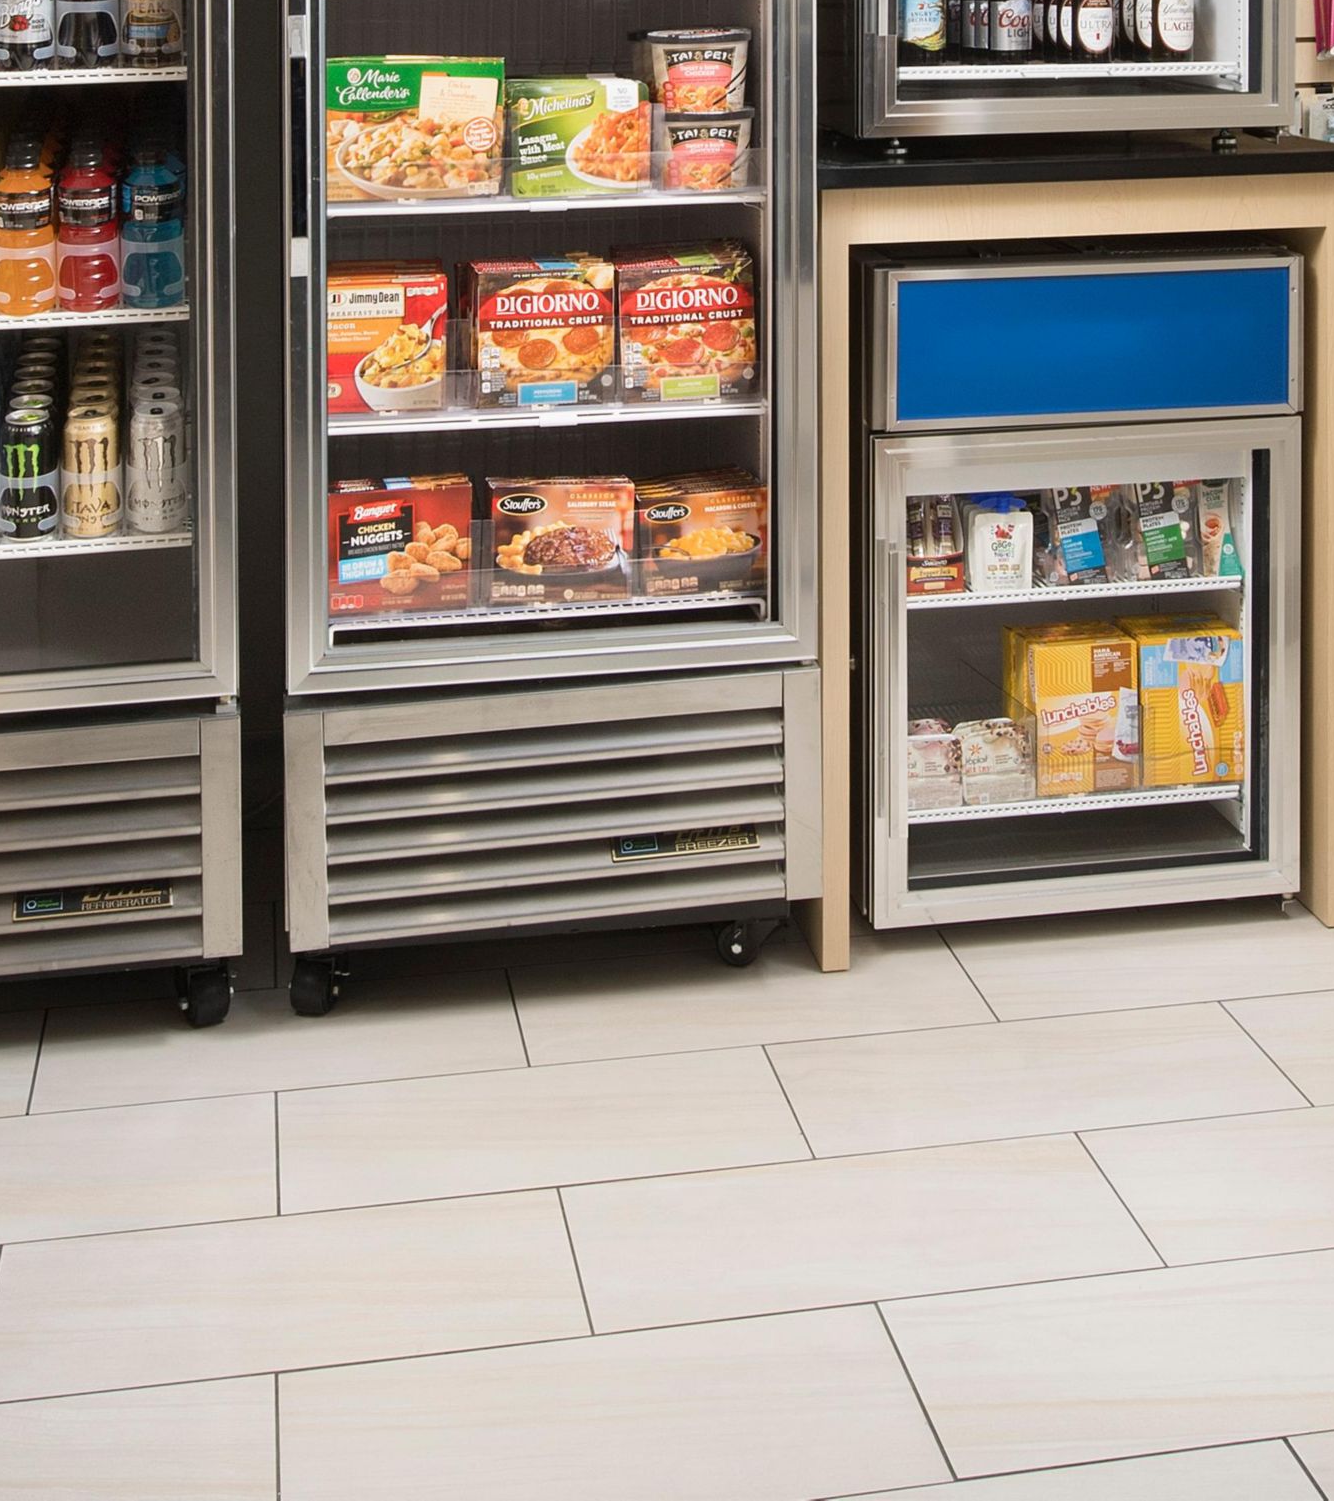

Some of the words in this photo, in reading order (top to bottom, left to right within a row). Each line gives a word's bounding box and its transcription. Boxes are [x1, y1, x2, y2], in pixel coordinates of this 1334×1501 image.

[672, 51, 693, 63] TAI
[703, 50, 727, 61] PEI
[359, 68, 400, 88] Marie
[336, 86, 409, 105] Callender's
[524, 94, 592, 120] Michelina's
[518, 133, 558, 146] Lasagna
[677, 128, 699, 139] TAI
[709, 128, 732, 138] PEI
[519, 146, 542, 156] with
[542, 141, 566, 152] Meat
[520, 155, 547, 165] Sauce
[349, 291, 378, 304] Jimmy
[378, 291, 400, 304] Dean
[489, 319, 565, 329] TRADITIONAL
[568, 315, 604, 325] CRUST
[630, 313, 705, 325] TRADITIONAL
[708, 309, 743, 319] CRUST
[503, 496, 543, 512] Stouffer's
[354, 503, 398, 521] Banquet
[650, 507, 686, 520] Stouffer's
[358, 522, 395, 534] CHICKEN
[350, 530, 403, 547] NUGGETS
[1042, 695, 1116, 726] lunchables
[1181, 689, 1210, 776] lunchables
[675, 837, 750, 852] FREEZER
[81, 895, 162, 912] REFRIGERATOR
